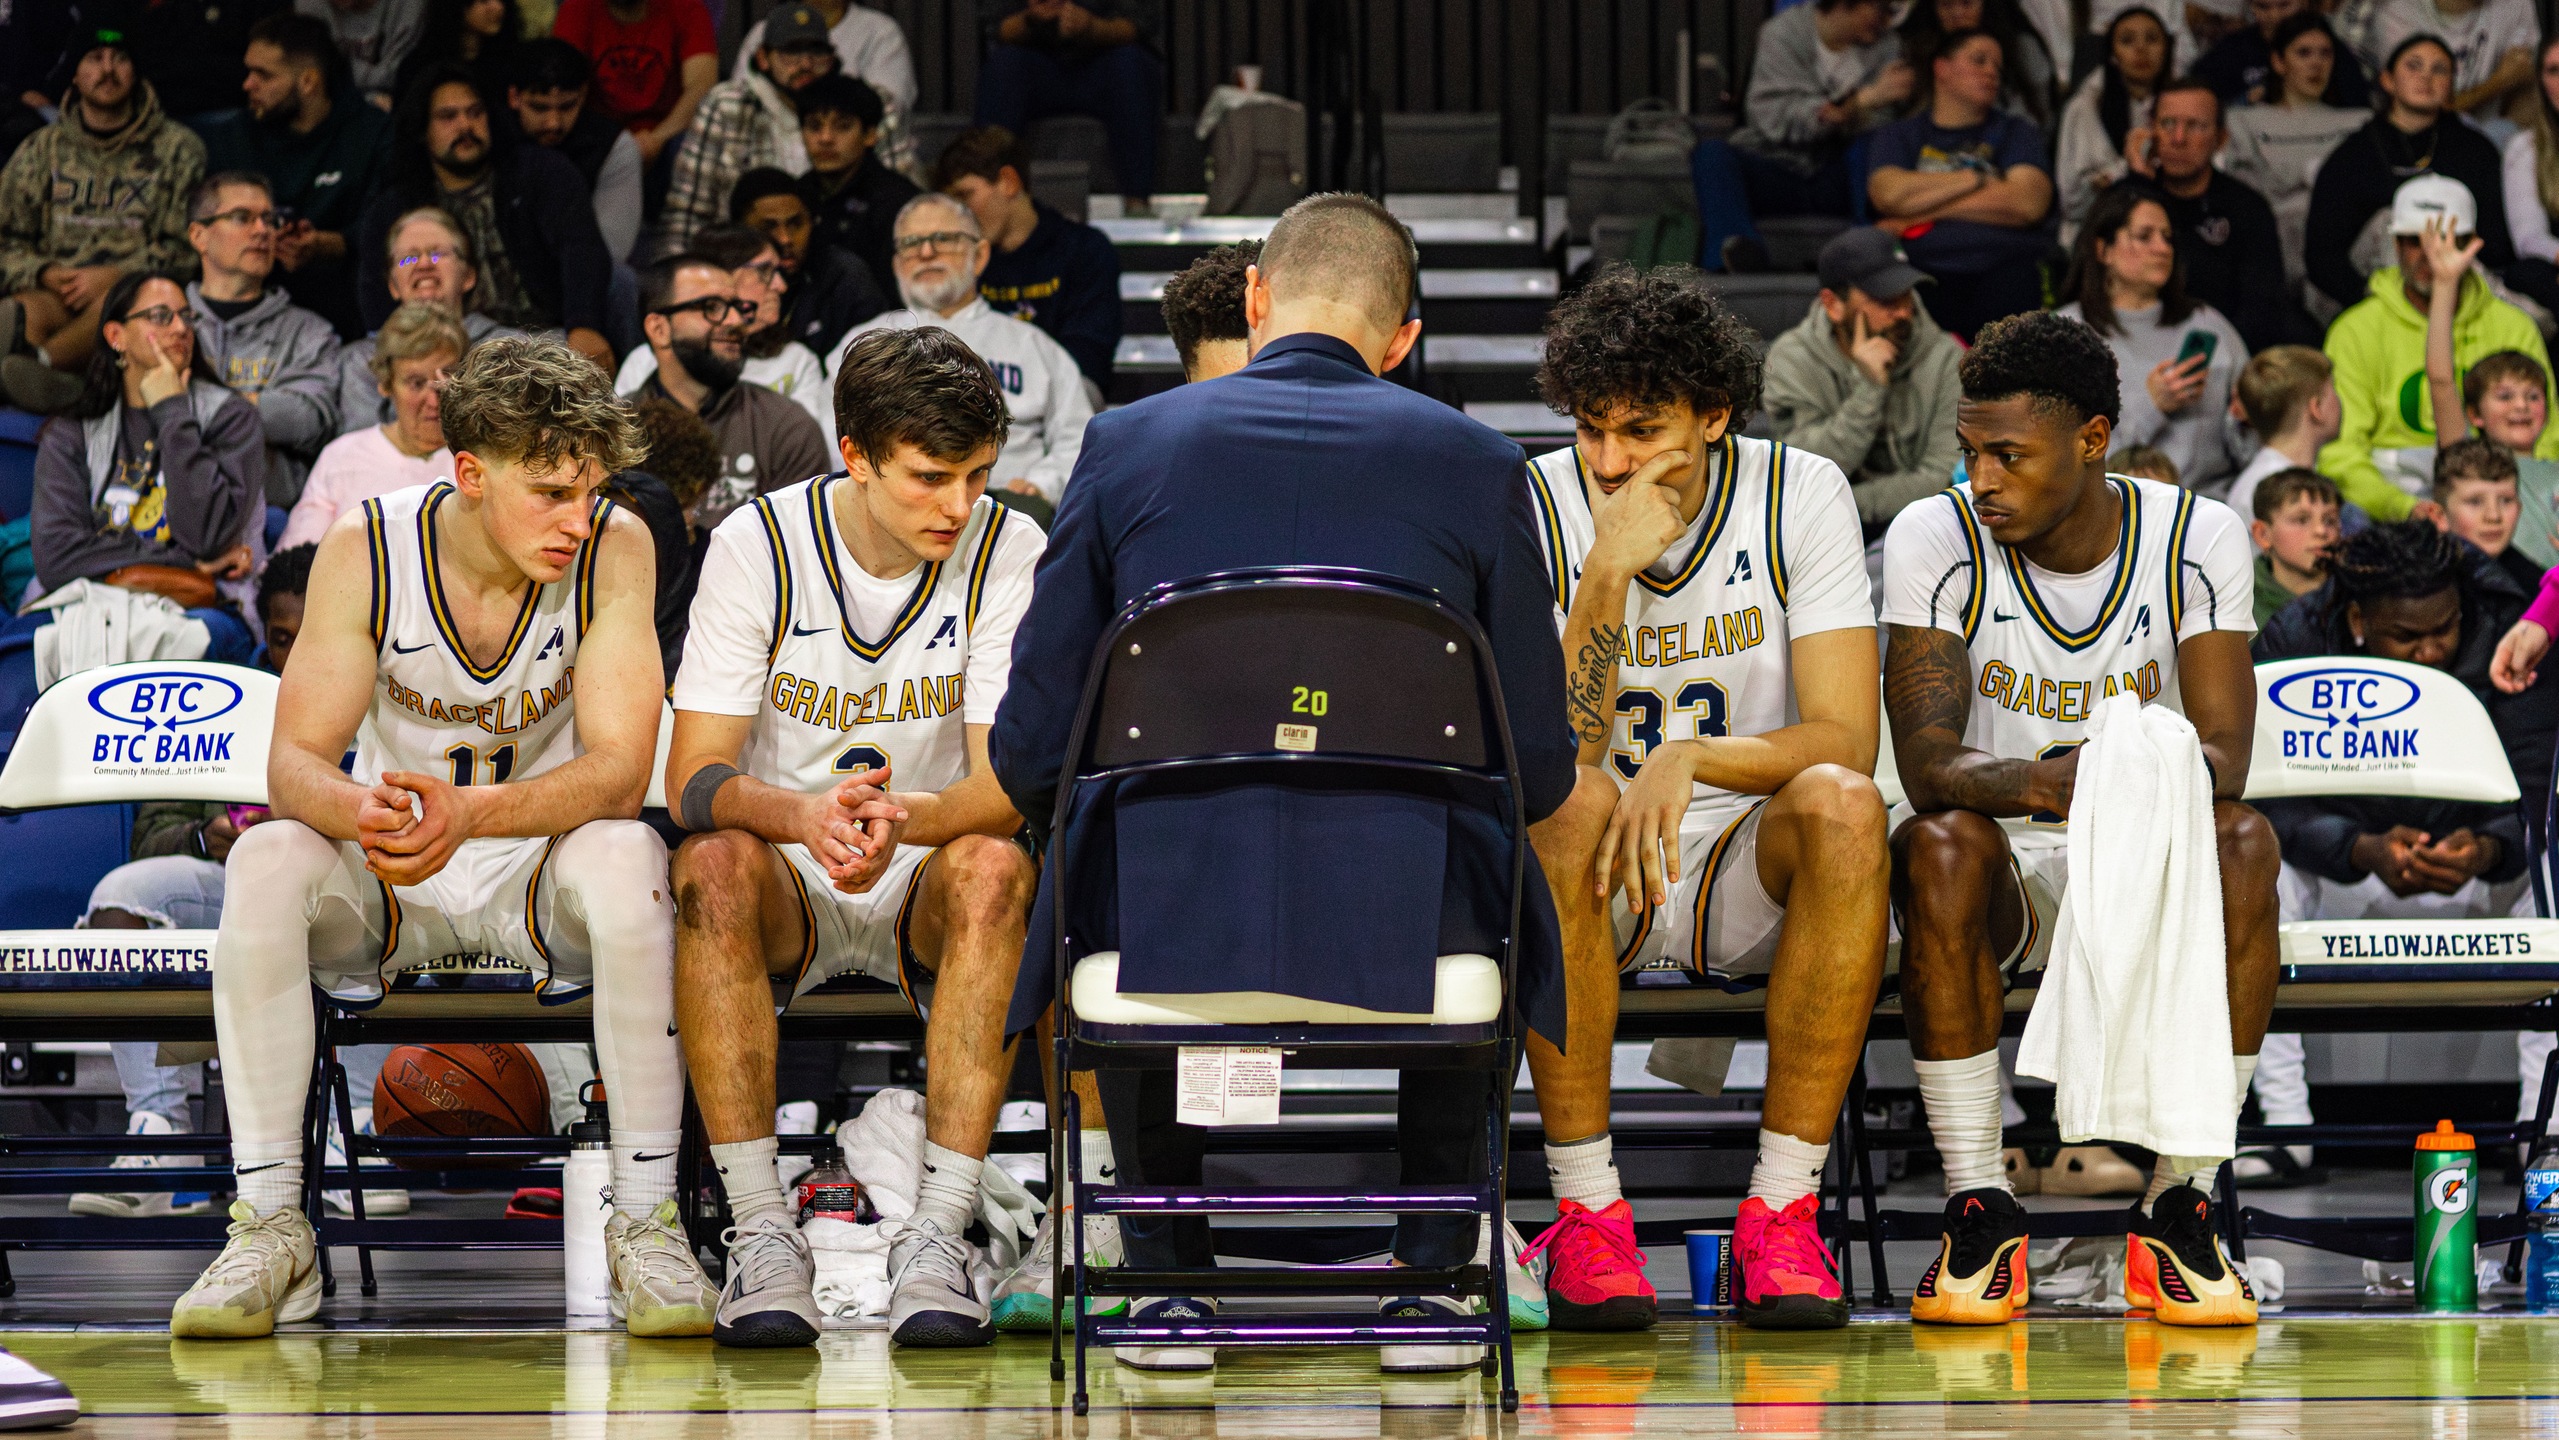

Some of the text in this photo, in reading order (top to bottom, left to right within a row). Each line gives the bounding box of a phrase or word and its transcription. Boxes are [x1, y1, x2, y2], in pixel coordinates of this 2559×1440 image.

[1619, 605, 1764, 668] ACELAND
[130, 682, 204, 713] BTC
[388, 666, 575, 735] GRACELAND
[771, 671, 964, 733] GRACELAND
[1292, 686, 1328, 716] 20
[2312, 679, 2380, 709] BTC
[1283, 726, 1308, 739] clarin
[1610, 676, 1731, 783] 33
[2283, 729, 2420, 759] BTC BANK
[92, 732, 235, 763] BTC BANK
[93, 766, 138, 777] Community
[193, 765, 209, 774] Like
[444, 740, 519, 787] 11
[2286, 762, 2329, 774] Community
[2384, 762, 2399, 770] Like
[0, 948, 208, 972] YELLOWJACKETS
[2322, 933, 2532, 958] YELLOWJACKETS
[2430, 1167, 2469, 1214] G
[1718, 1236, 1730, 1303] POWERADE
